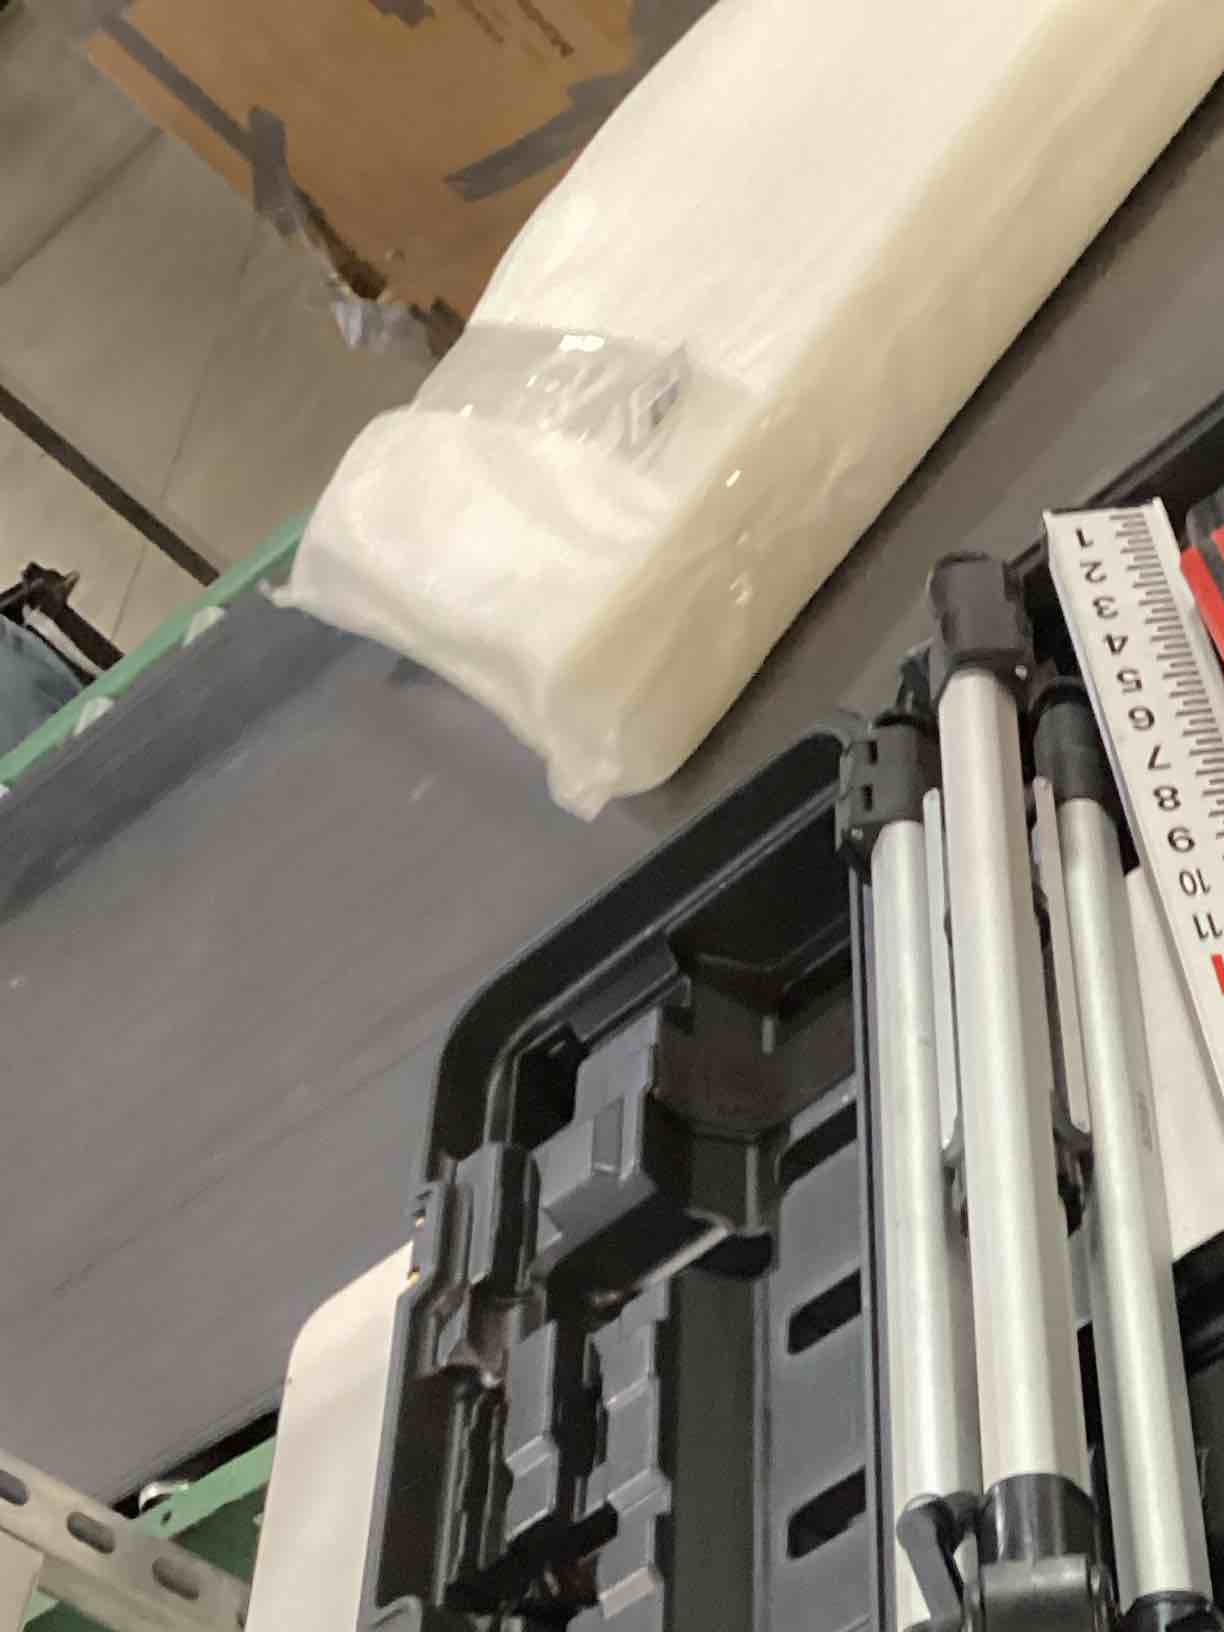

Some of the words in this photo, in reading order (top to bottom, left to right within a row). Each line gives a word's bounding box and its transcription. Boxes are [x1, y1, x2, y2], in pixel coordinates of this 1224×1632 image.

[1075, 528, 1094, 548] 1
[1079, 561, 1107, 583] 2
[1092, 596, 1118, 619] 3
[1104, 634, 1128, 656] 4
[1116, 668, 1142, 693] 5
[1128, 705, 1155, 731] 6
[1147, 745, 1171, 770] 7
[1153, 785, 1181, 811] 8
[1167, 826, 1196, 853] 9
[1179, 868, 1212, 896] 10
[1193, 912, 1223, 940] 11
